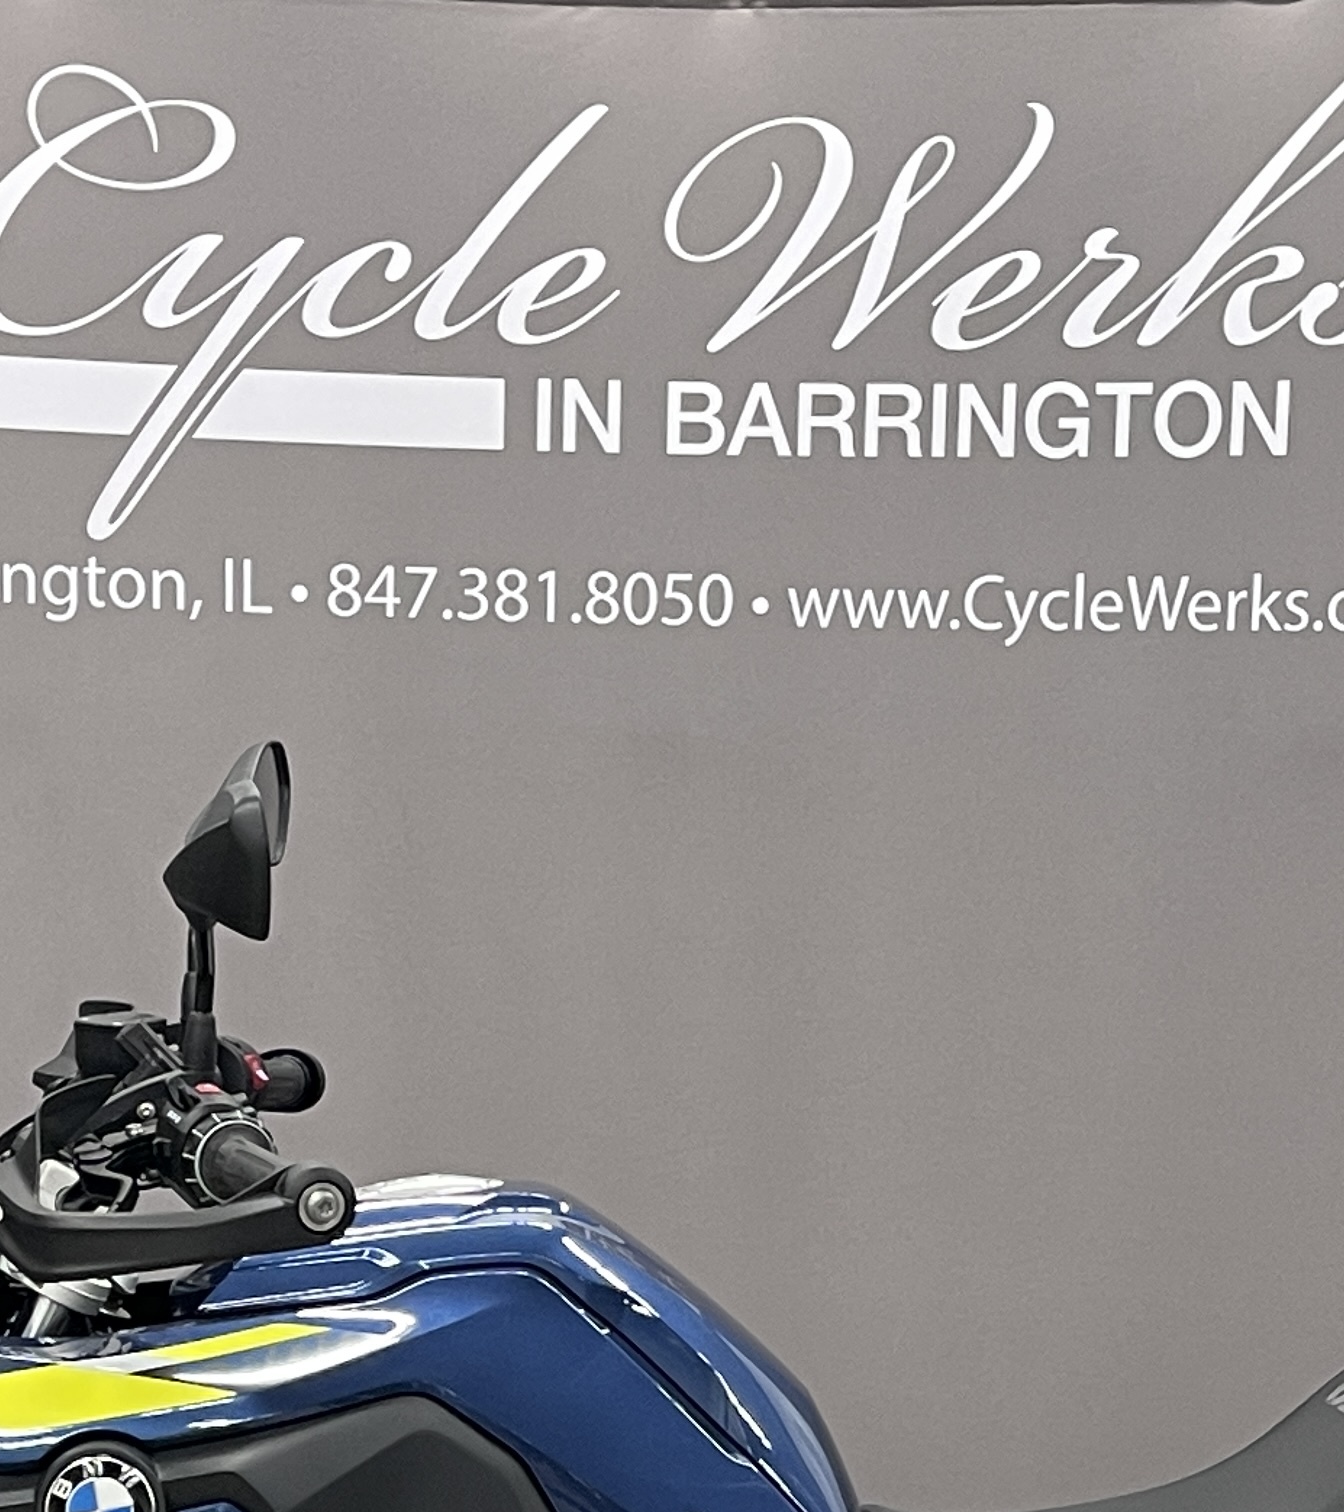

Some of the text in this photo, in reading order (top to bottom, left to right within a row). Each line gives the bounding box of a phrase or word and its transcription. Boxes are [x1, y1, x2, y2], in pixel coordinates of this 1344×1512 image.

[536, 377, 1292, 459] IN BARRINGTON
[224, 557, 273, 614] IL
[327, 563, 734, 627] 847.381.8050
[52, 1456, 142, 1501] BMW
